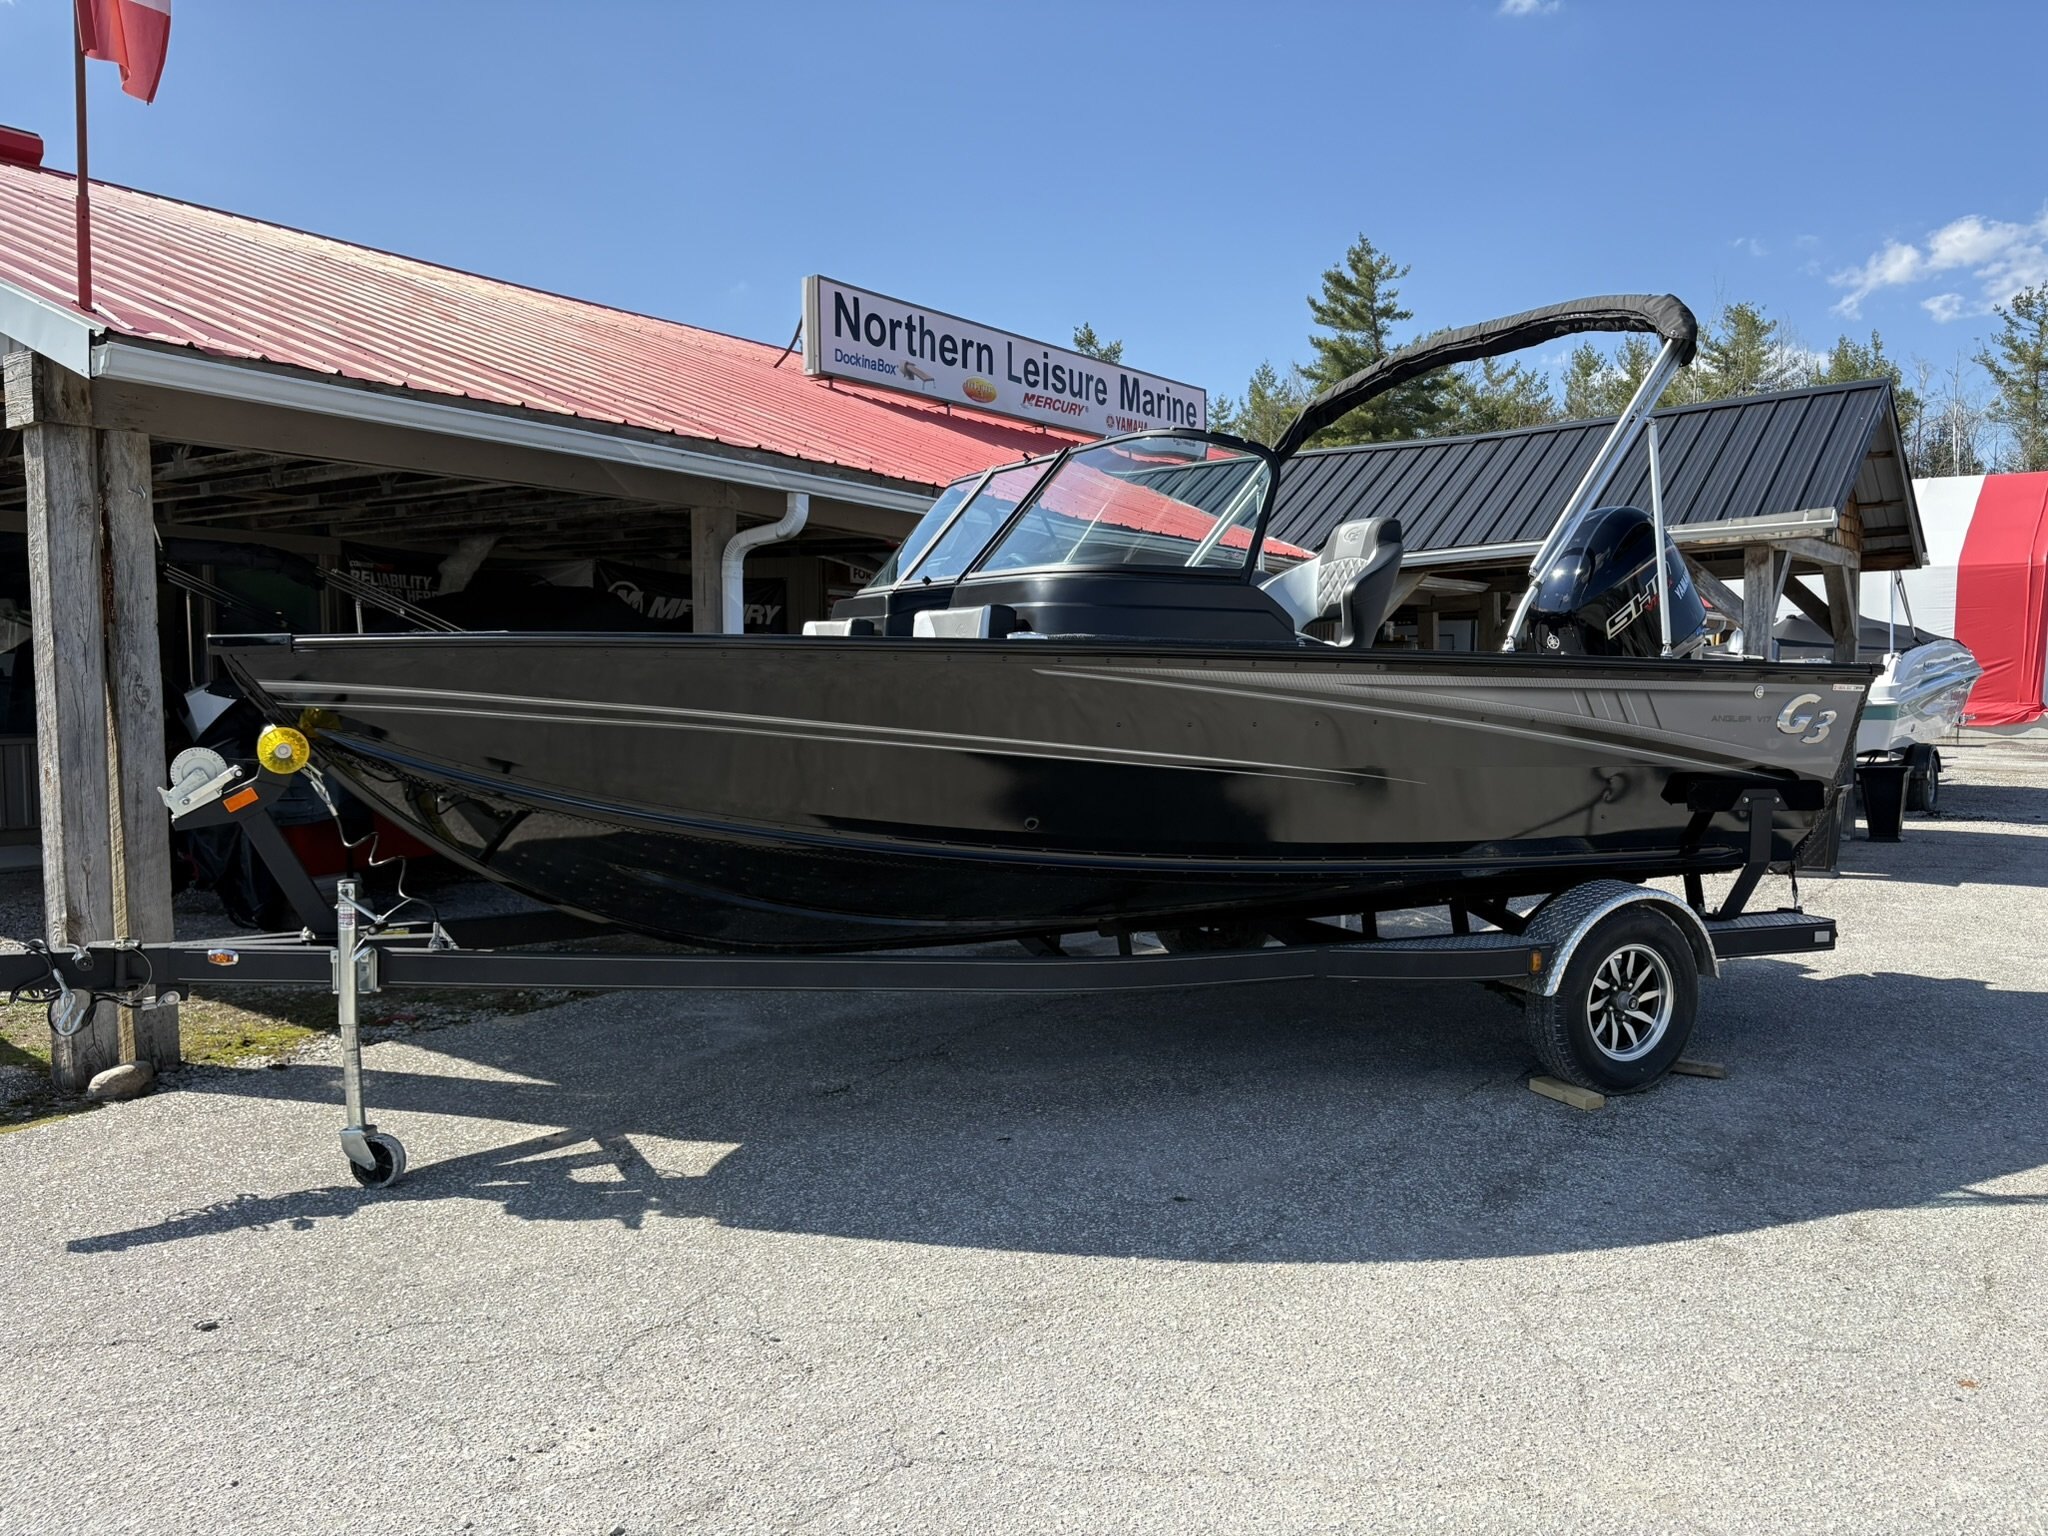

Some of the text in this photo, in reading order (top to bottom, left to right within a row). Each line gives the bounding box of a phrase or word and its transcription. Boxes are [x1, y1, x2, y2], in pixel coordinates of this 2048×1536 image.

[834, 291, 1197, 428] Northern Leisure Marine
[834, 348, 897, 375] DockinaBox
[1023, 392, 1086, 417] MERCURY
[350, 569, 433, 591] RELIABILITY
[1711, 714, 1752, 723] ANGLER
[1776, 693, 1837, 744] G3
